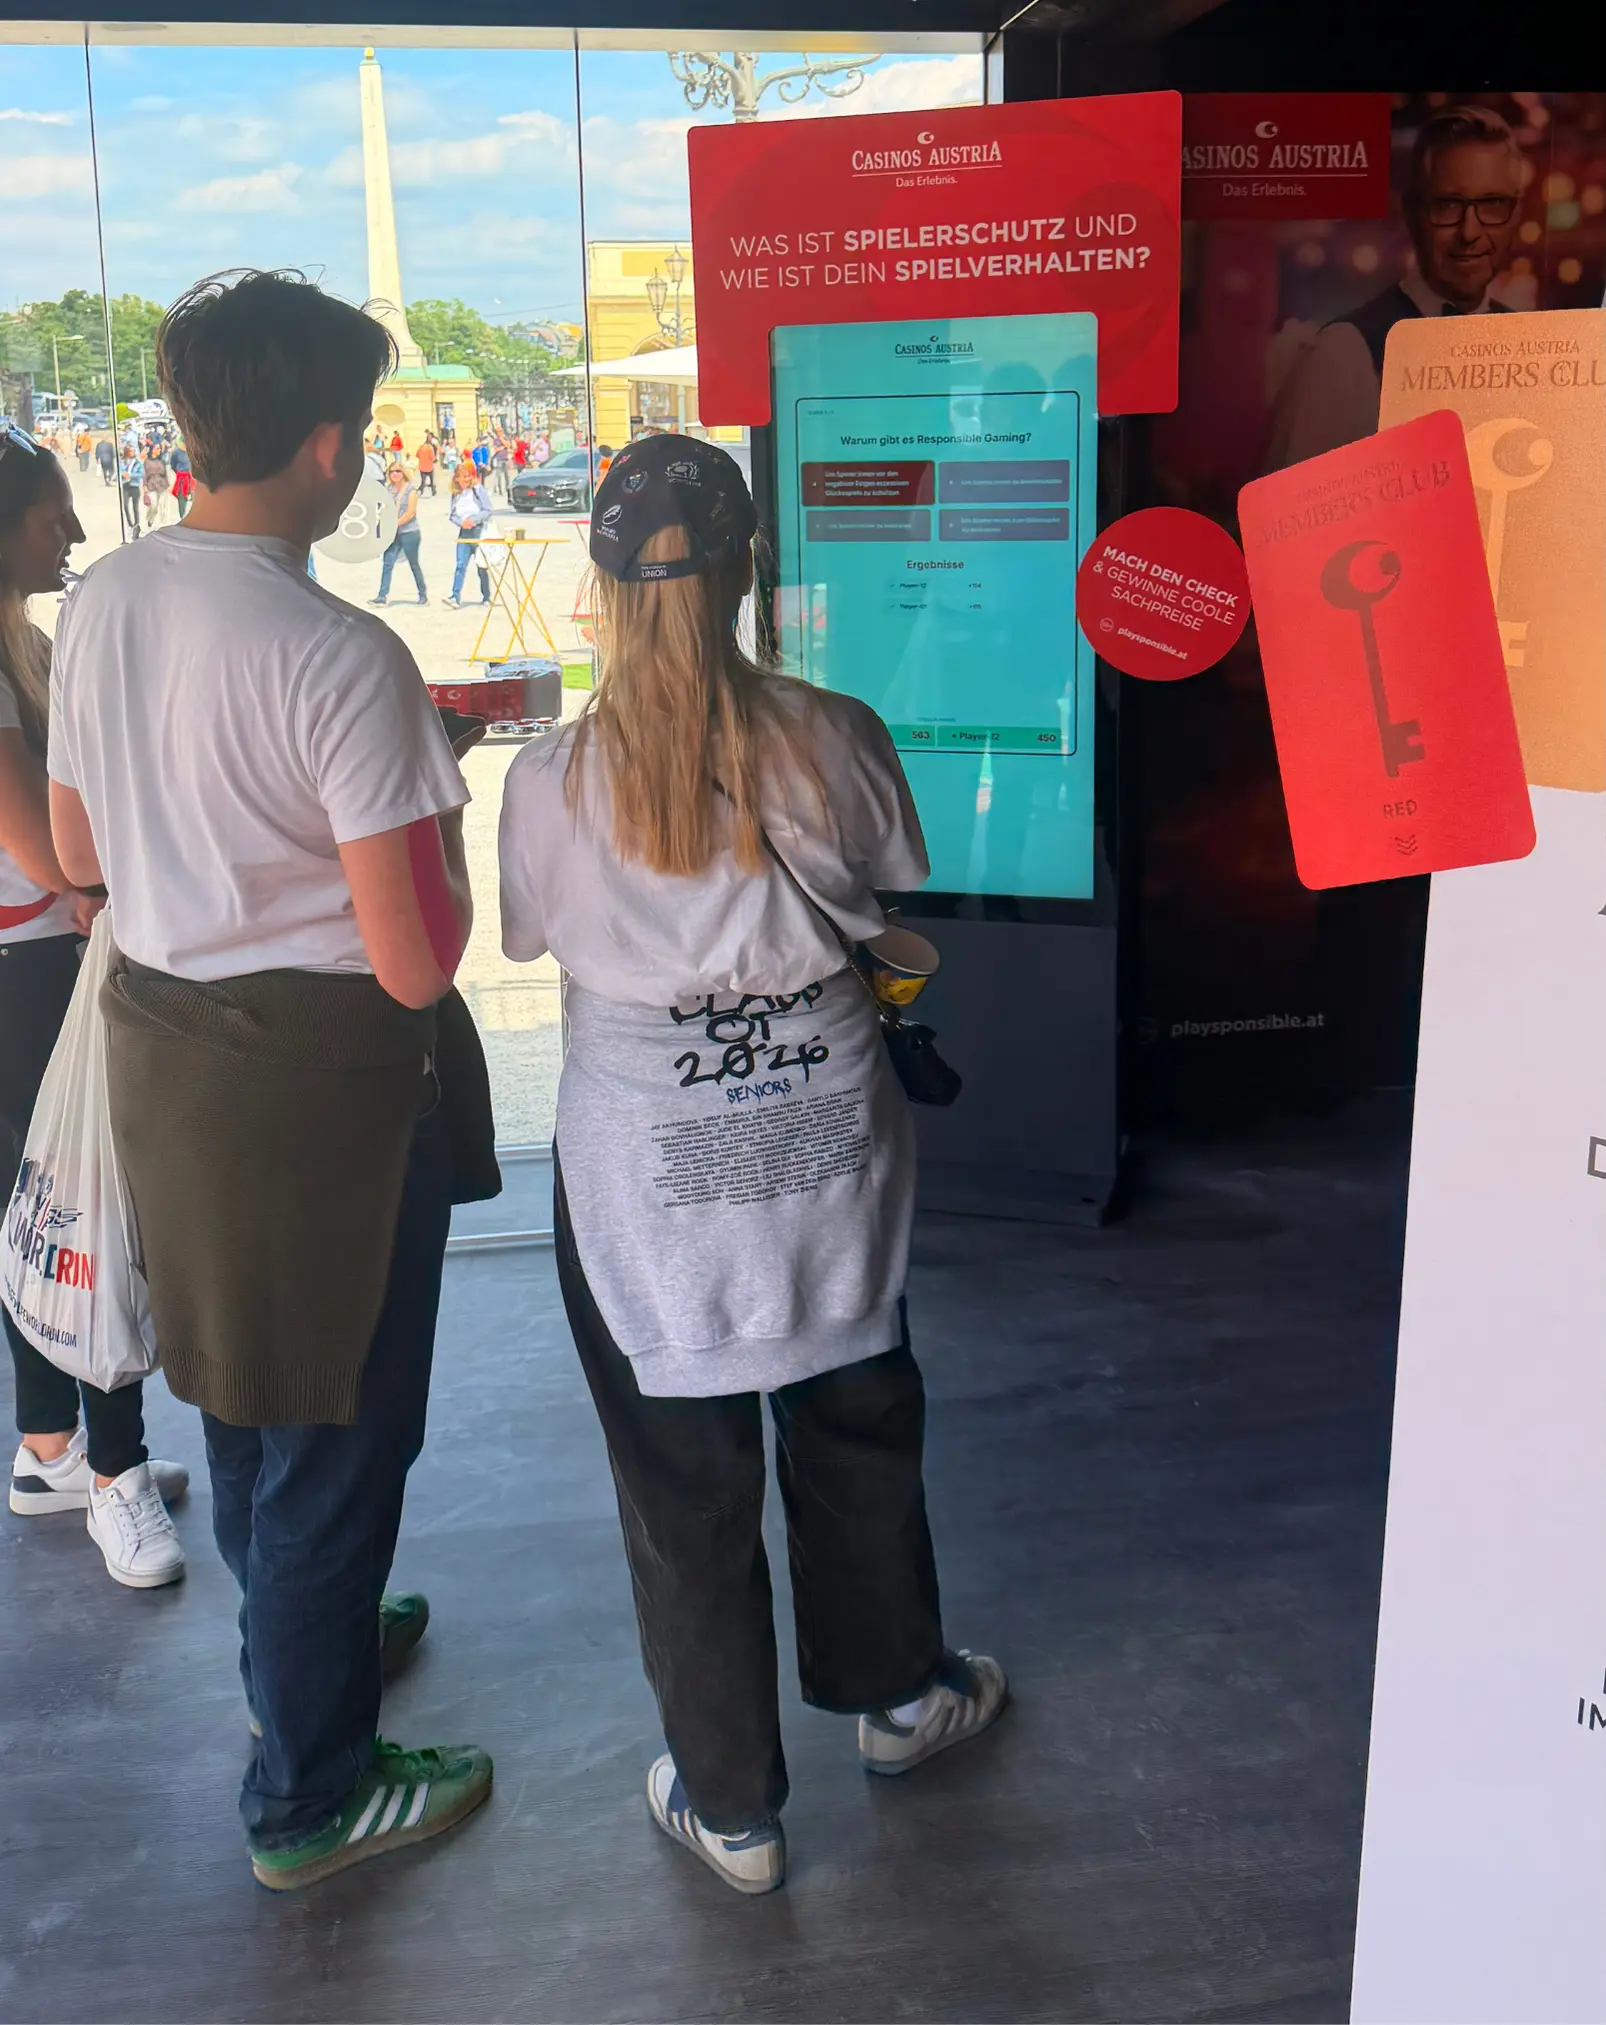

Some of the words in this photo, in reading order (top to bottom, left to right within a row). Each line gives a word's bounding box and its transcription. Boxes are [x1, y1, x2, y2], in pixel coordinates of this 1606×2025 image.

[852, 148, 922, 172] CASINOS
[929, 141, 1002, 166] AUSTRIA
[1181, 146, 1259, 169] ASINOS
[1269, 142, 1368, 168] AUSTRIA
[895, 177, 915, 188] Das
[917, 174, 958, 187] Erlebnis.
[1223, 183, 1248, 196] Das
[1252, 182, 1307, 196] Erlebnis.
[730, 236, 789, 257] WAS
[798, 232, 835, 254] IST
[844, 217, 1066, 252] SPIELERSCHUTZ
[1074, 213, 1137, 238] UND
[720, 268, 769, 290] WIE
[778, 265, 813, 287] IST
[825, 261, 886, 285] DEIN
[895, 247, 1151, 282] SPIELVERHALTEN?
[895, 344, 932, 354] CASINOS
[936, 342, 974, 353] AUSTRIA
[1451, 342, 1512, 358] CASINOS
[1516, 340, 1580, 356] AUSTRIA
[1400, 360, 1539, 391] MEMBERS
[841, 435, 877, 445] Warum
[879, 434, 900, 447] gibt
[902, 435, 915, 444] es
[917, 433, 982, 447] Responsible
[984, 432, 1032, 445] Gaming?
[1379, 461, 1450, 502] CLUB
[641, 570, 667, 578] UNION
[907, 560, 964, 571] Ergebnisse
[1103, 546, 1148, 572] MACH
[1150, 565, 1183, 586] DEN
[1186, 579, 1239, 607] CHECK
[1093, 561, 1102, 574] &
[1107, 566, 1180, 603] GEWINNE
[1181, 596, 1235, 625] COOLE
[1111, 586, 1204, 631] SACHPREISE
[1117, 627, 1188, 660] playsponsible.at
[1037, 734, 1056, 742] 450
[1383, 800, 1418, 819] RED
[1170, 1012, 1324, 1038] playsponsible.at
[674, 1035, 829, 1087] 2026
[727, 1078, 792, 1104] SENIORS
